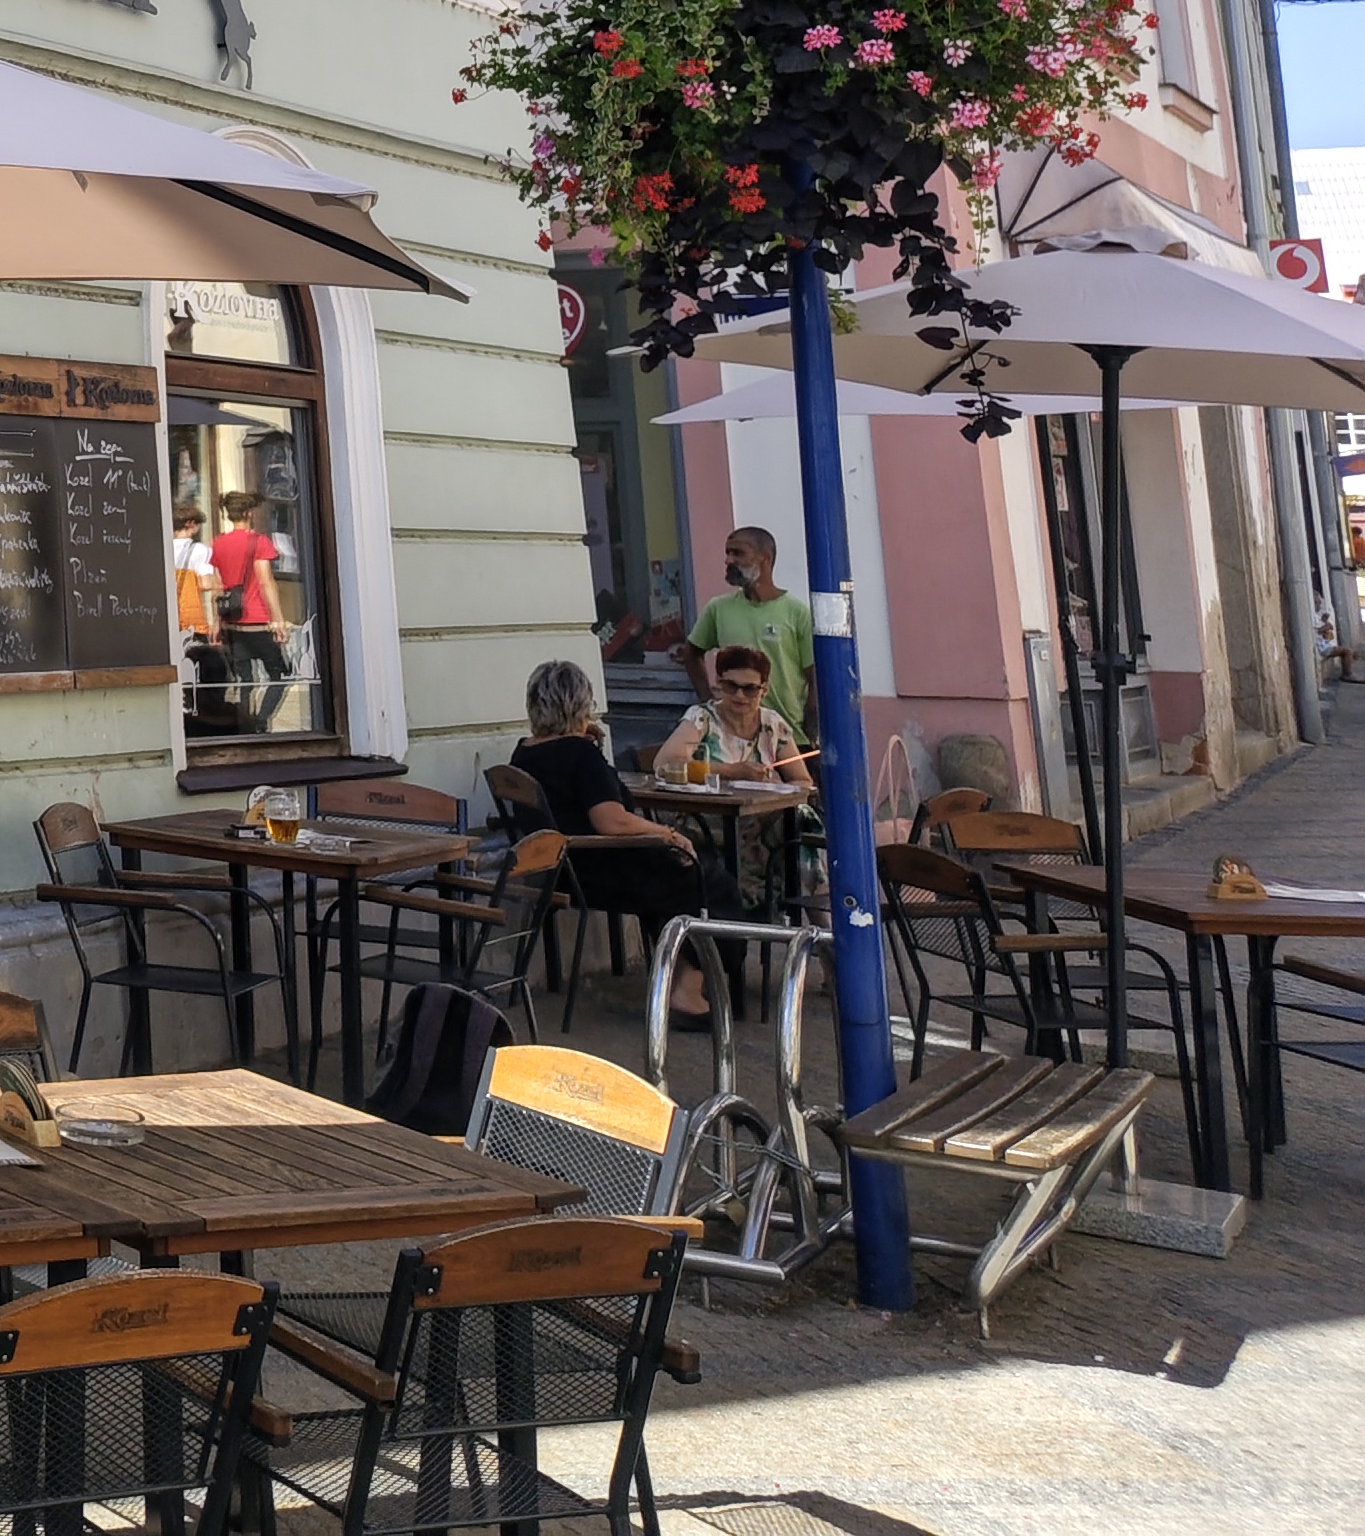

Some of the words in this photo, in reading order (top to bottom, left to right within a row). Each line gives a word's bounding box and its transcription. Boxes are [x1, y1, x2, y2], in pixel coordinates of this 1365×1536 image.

[65, 464, 93, 487] Kozel
[67, 491, 92, 517] Kozel
[70, 521, 93, 546] Kozel
[70, 557, 107, 584] Plzeň
